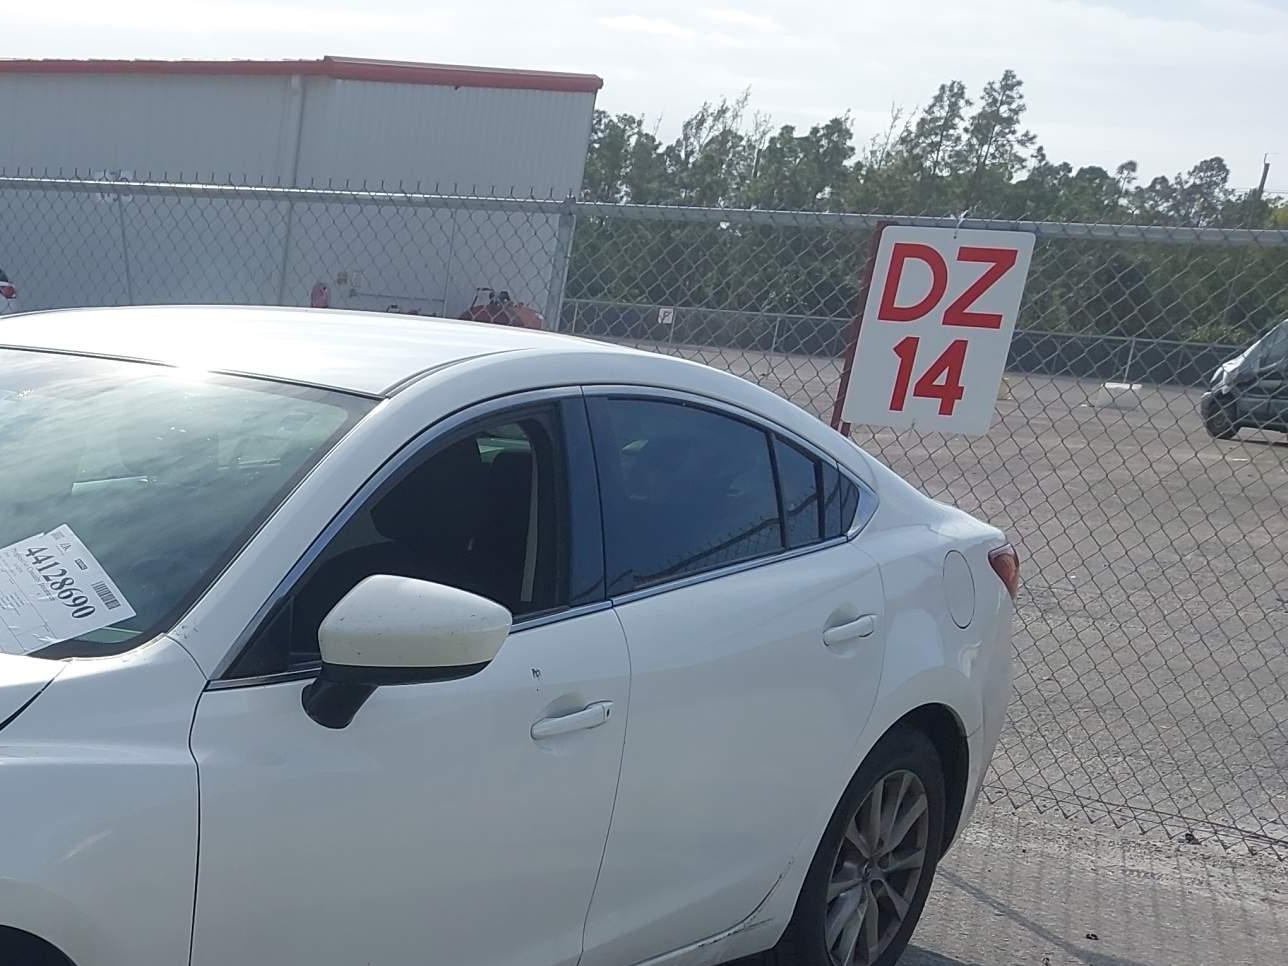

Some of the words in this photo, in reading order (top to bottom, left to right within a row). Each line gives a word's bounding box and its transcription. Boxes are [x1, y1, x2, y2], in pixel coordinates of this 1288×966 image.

[877, 242, 1018, 329] DZ
[889, 336, 969, 416] 14
[24, 546, 96, 619] 44128690
